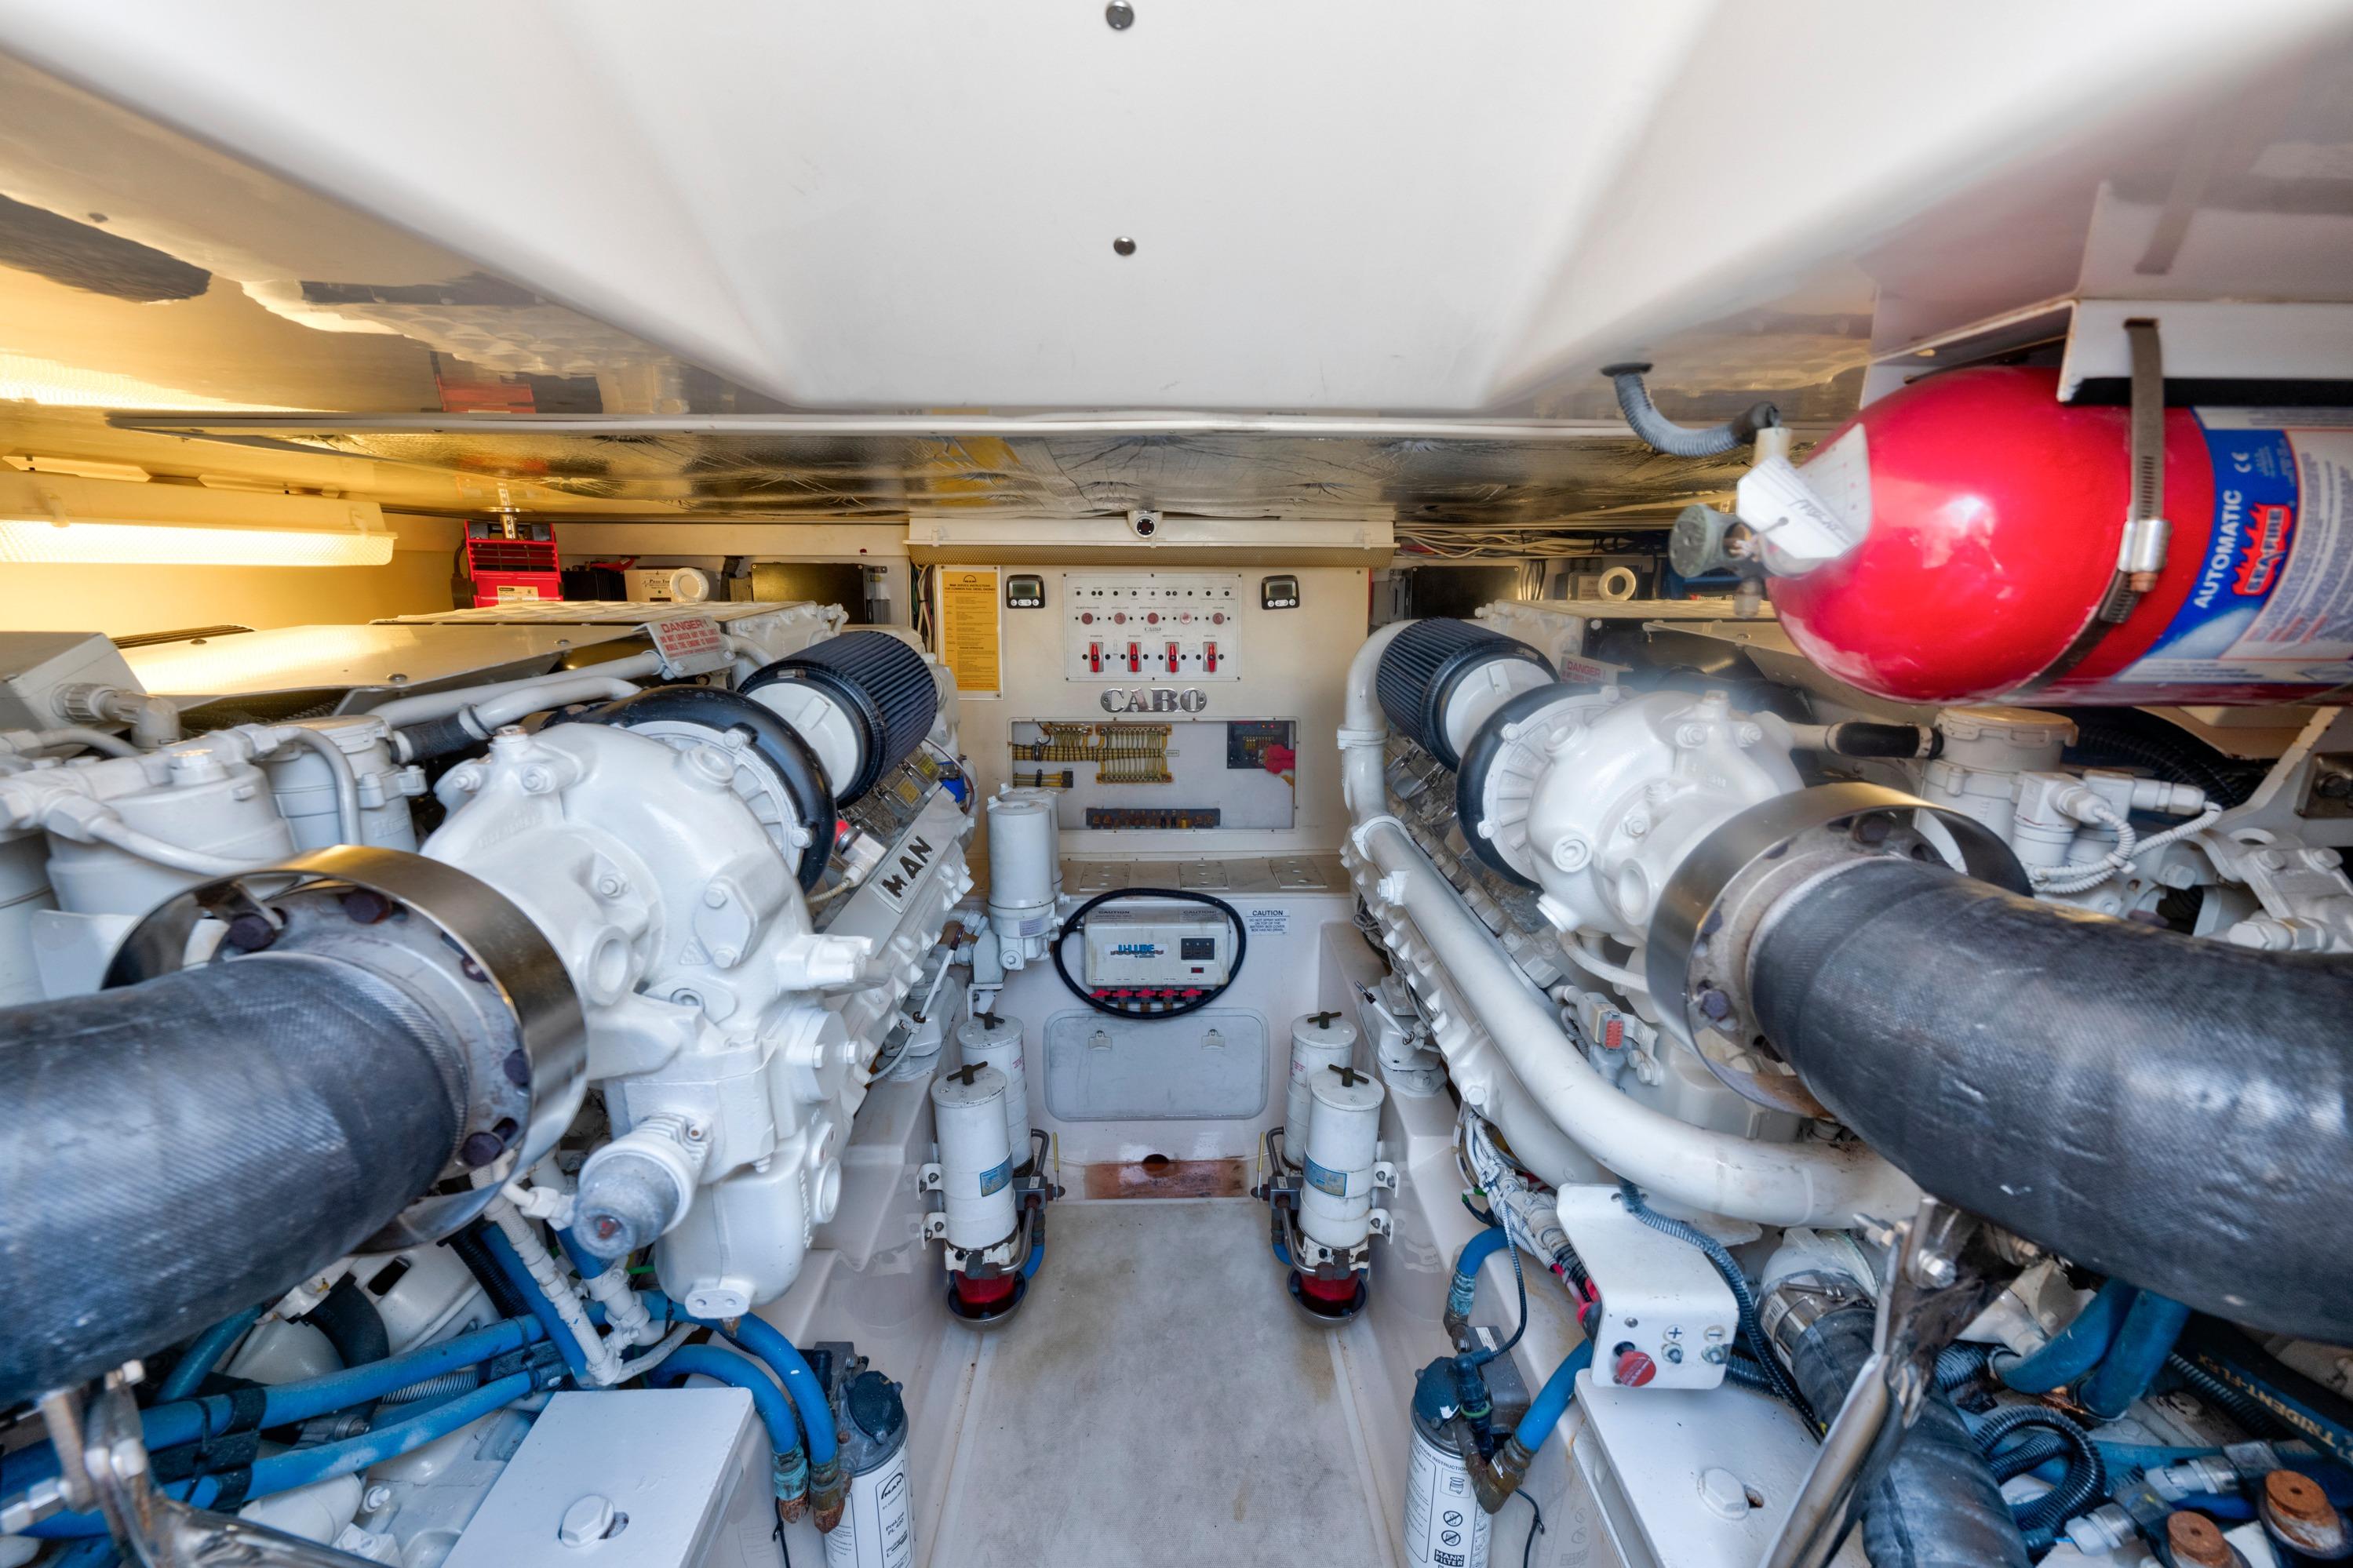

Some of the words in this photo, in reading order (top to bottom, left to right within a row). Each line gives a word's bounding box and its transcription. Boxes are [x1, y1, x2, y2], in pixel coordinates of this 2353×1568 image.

[2194, 489, 2242, 609] AUTOMATIC
[661, 620, 704, 633] DANGER
[1568, 661, 1601, 678] DANGER
[1101, 687, 1207, 712] CABO
[880, 835, 934, 899] MAN
[884, 1478, 902, 1497] MAN
[1435, 1555, 1464, 1566] FILTER
[1436, 1550, 1464, 1561] MANN
